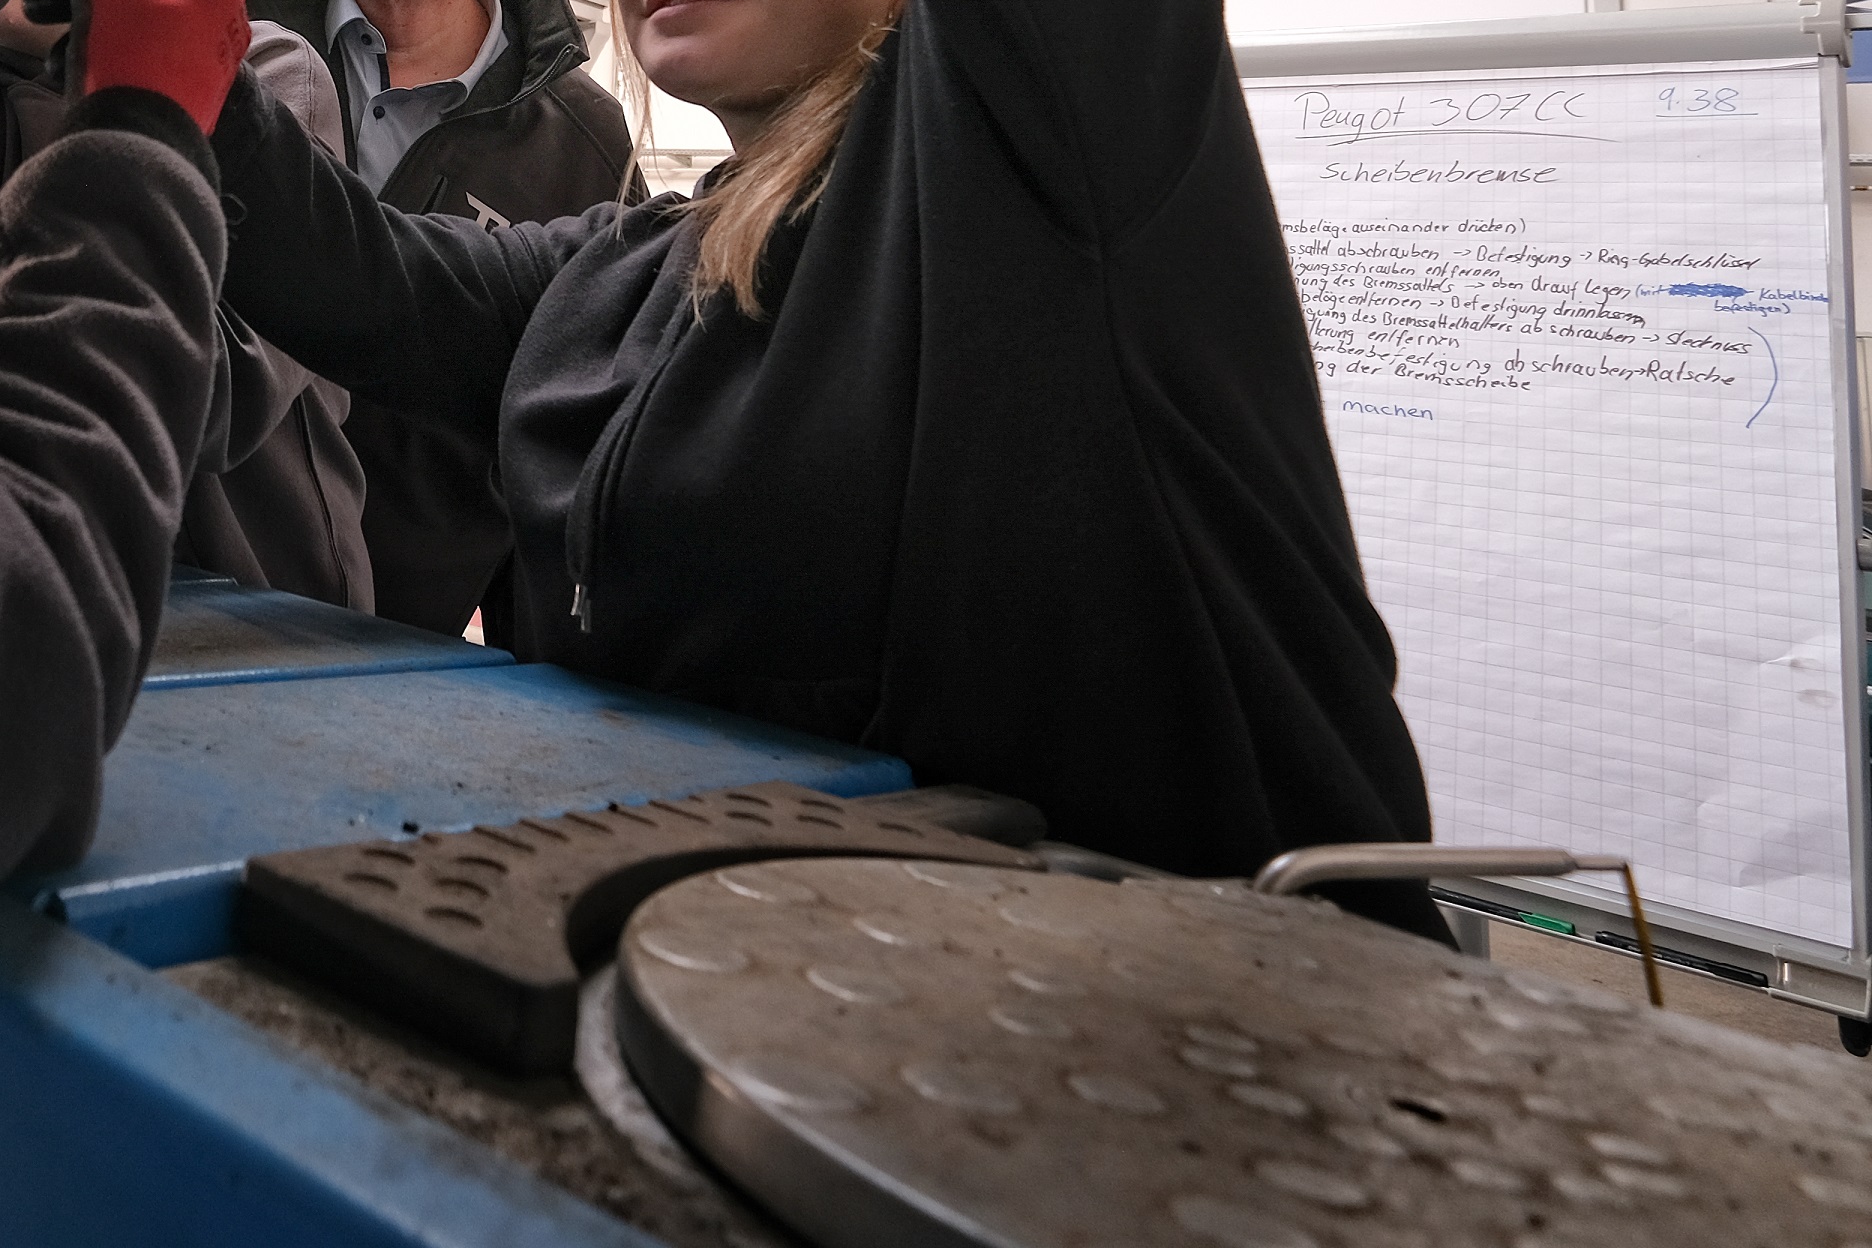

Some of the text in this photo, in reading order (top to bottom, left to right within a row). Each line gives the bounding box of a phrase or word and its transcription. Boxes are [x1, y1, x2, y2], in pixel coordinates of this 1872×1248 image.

[1658, 86, 1740, 112] 9.38
[1294, 91, 1405, 144] Peugot
[1282, 218, 1347, 238] msbeläge
[1288, 239, 1331, 257] ssattel
[1333, 273, 1356, 287] des
[1491, 277, 1524, 290] oben
[1351, 308, 1378, 324] des
[1345, 359, 1383, 376] der
[1342, 400, 1434, 421] machen
